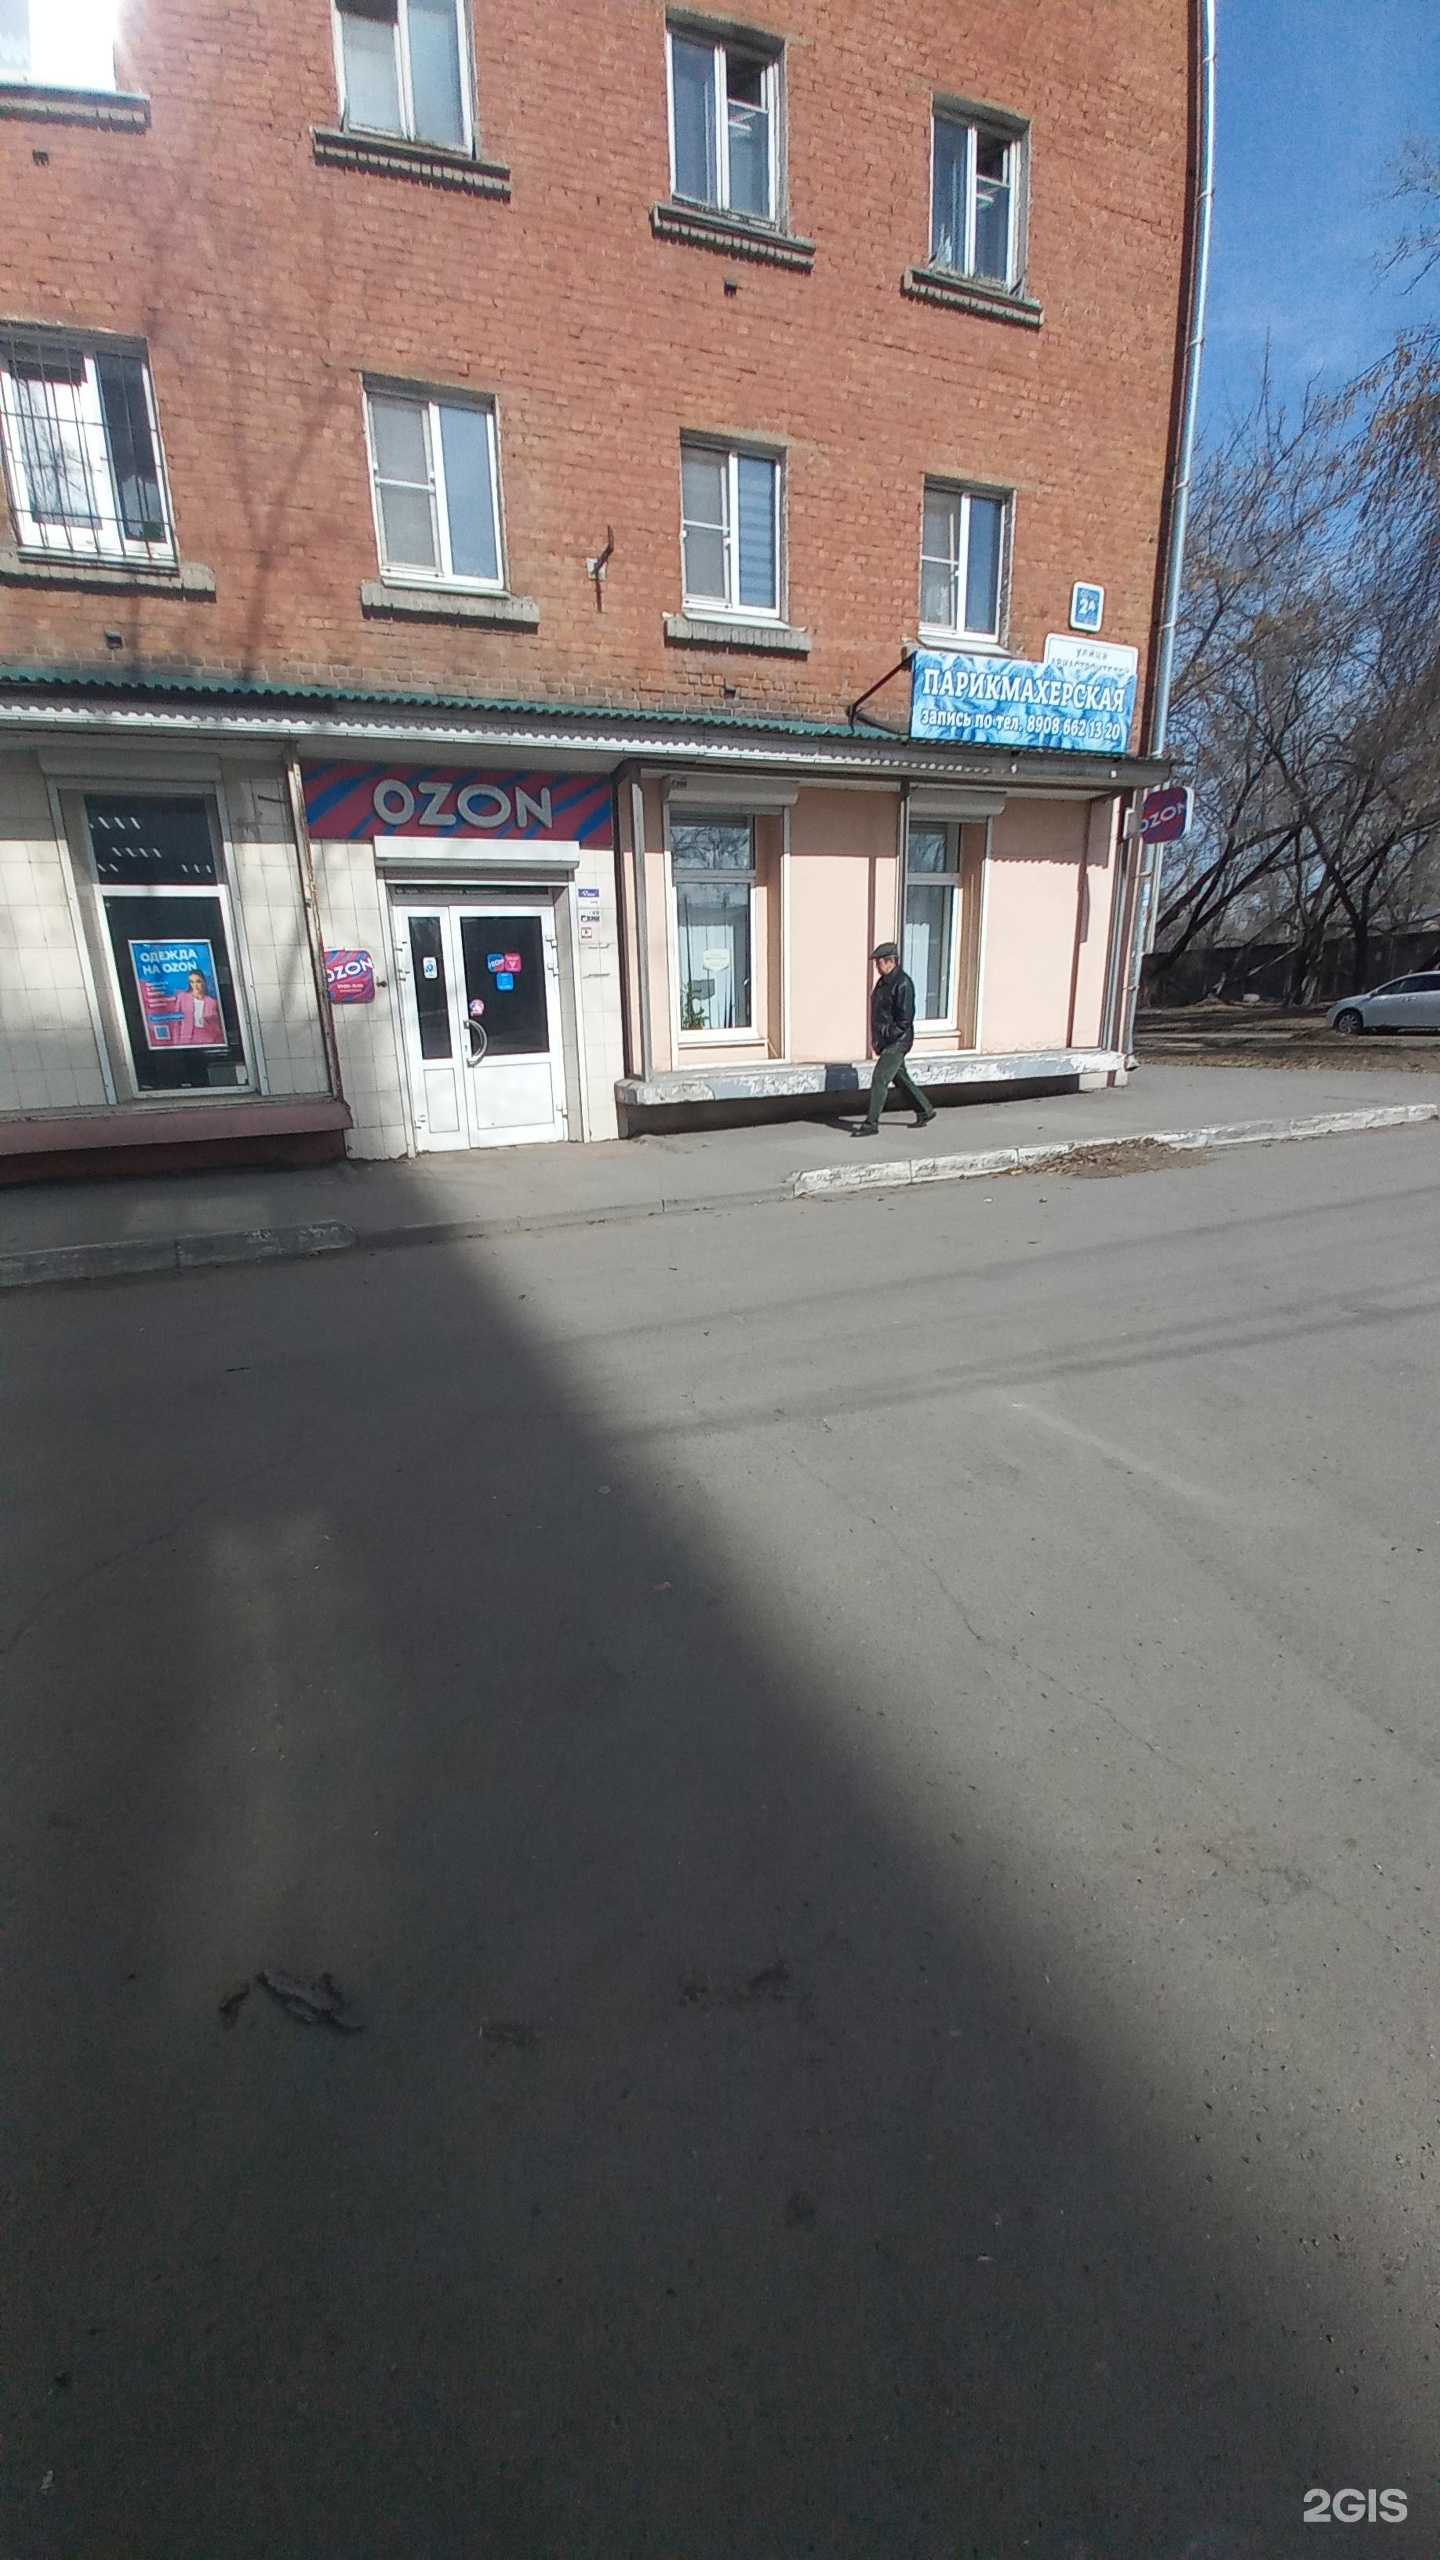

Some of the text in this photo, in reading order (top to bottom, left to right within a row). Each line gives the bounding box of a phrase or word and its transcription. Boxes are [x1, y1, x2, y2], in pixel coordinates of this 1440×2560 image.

[923, 668, 1125, 713] ПАРИКМАХЕРСКАЯ
[921, 709, 1121, 740] запись по тел. 8908 662 13 20
[373, 779, 552, 828] OZON
[140, 949, 198, 964] ОДЕЖДА
[143, 961, 198, 975] НА OZON
